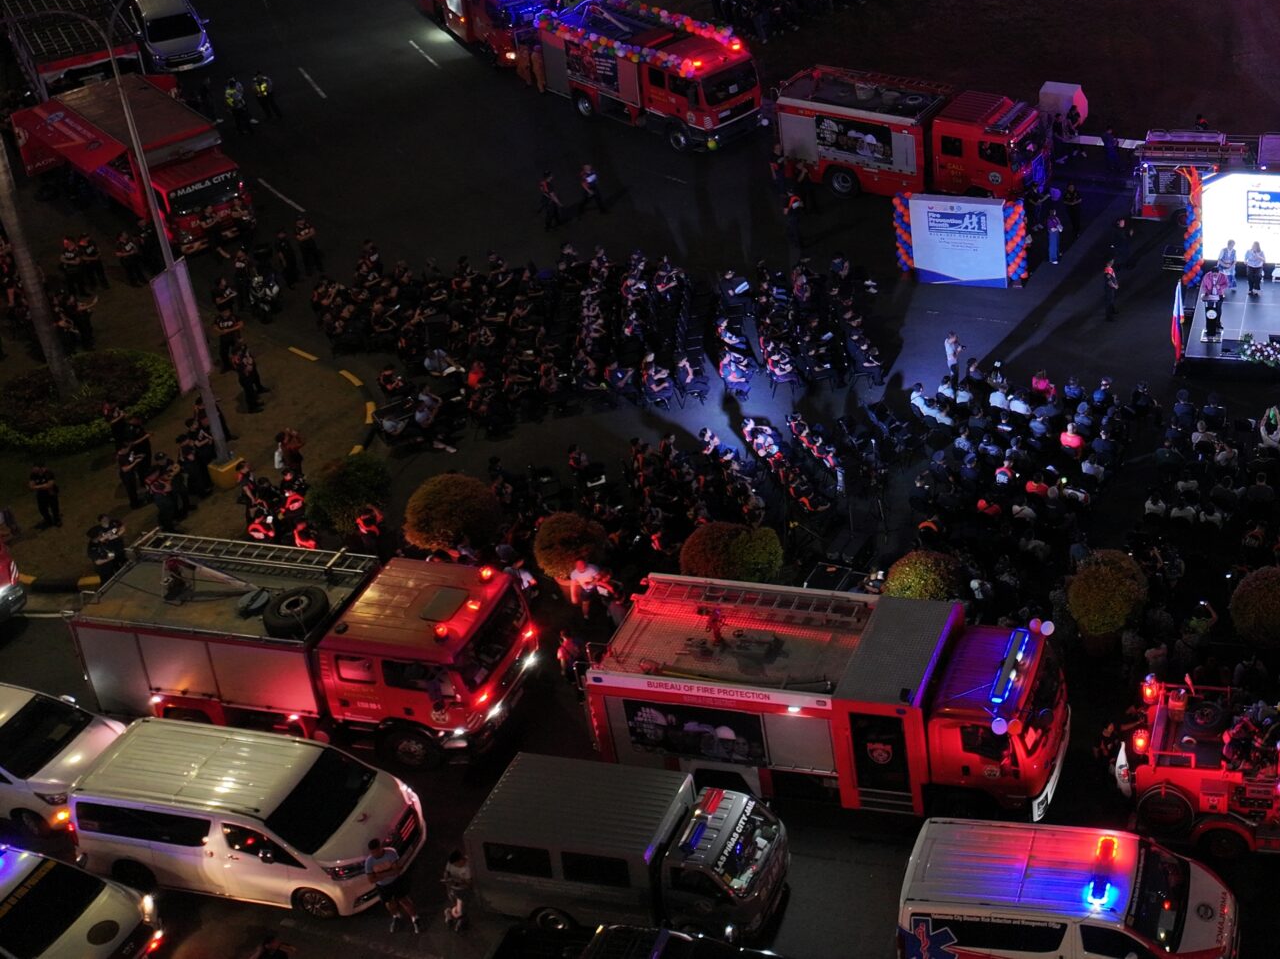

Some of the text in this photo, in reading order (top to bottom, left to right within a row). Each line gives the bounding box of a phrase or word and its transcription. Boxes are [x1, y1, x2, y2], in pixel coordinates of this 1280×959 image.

[176, 171, 235, 197] MANILA CITY
[646, 681, 681, 691] BUREAU
[683, 684, 695, 692] OF
[696, 686, 716, 695] FIRE
[717, 688, 771, 701] PROTECTION
[735, 816, 748, 834] CITY
